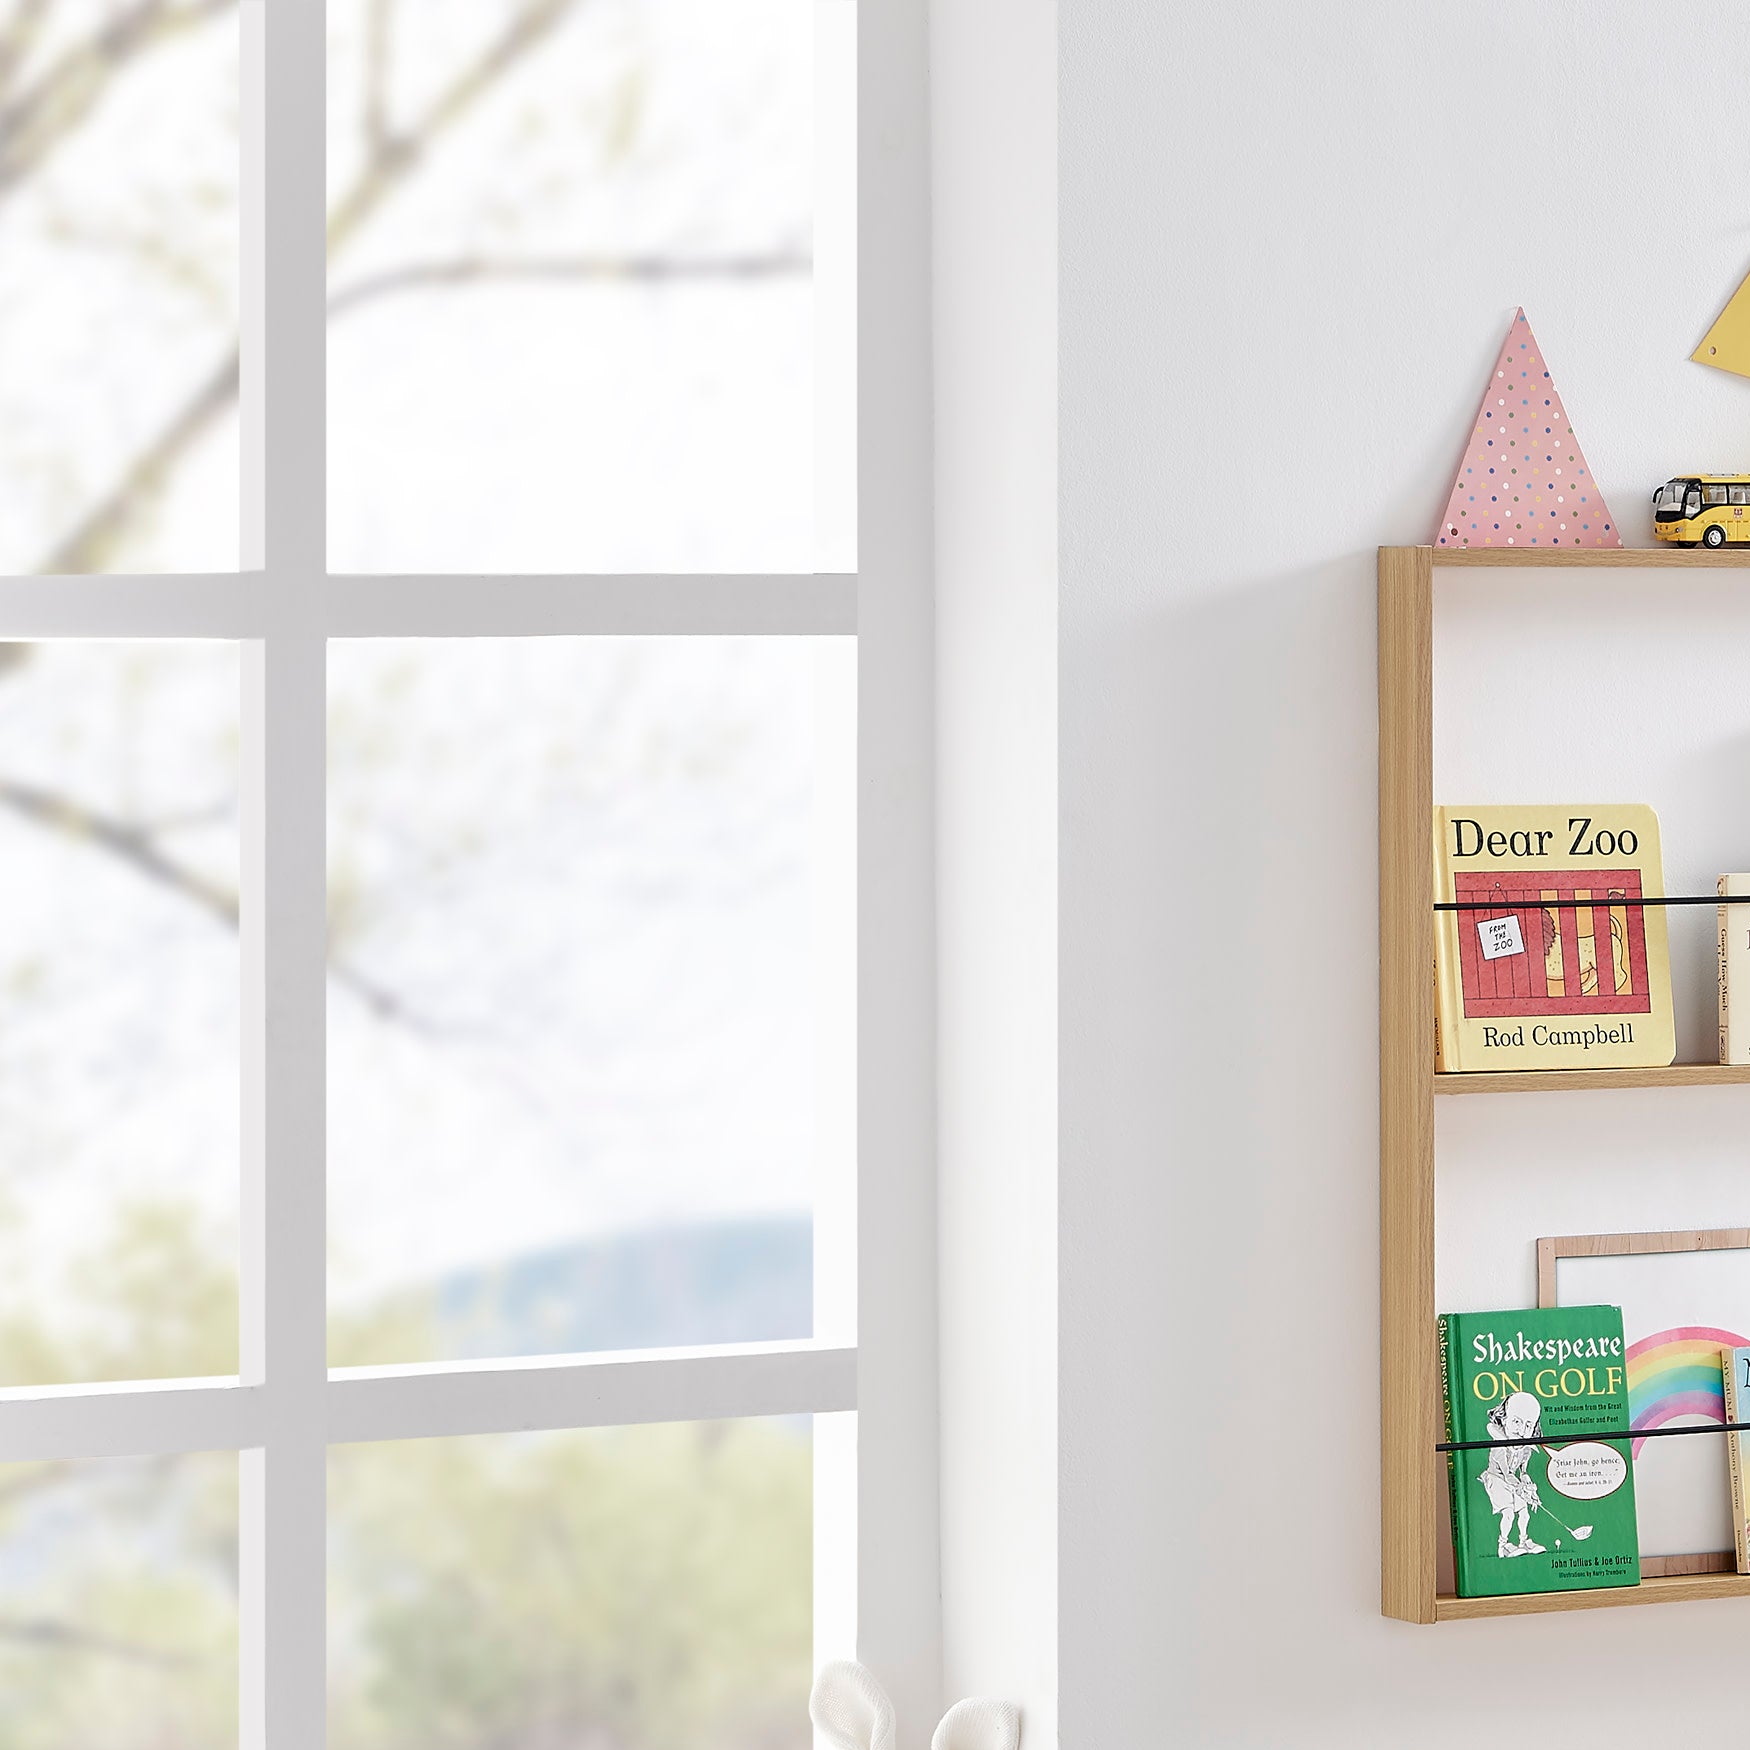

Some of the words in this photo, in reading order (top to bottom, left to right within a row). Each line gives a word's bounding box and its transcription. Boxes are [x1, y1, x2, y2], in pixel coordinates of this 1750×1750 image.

[1451, 819, 1554, 857] Dear
[1568, 818, 1639, 856] Zoo
[1489, 923, 1507, 934] FROM
[1493, 938, 1513, 951] ZOO
[1483, 1026, 1525, 1047] Rod
[1532, 1023, 1634, 1049] Campbell
[1438, 1319, 1449, 1396] Shakespeare
[1472, 1331, 1622, 1366] Shakespeare
[1723, 1360, 1730, 1378] MY
[1473, 1370, 1524, 1401] ON
[1534, 1366, 1623, 1398] GOLF
[1725, 1382, 1733, 1412] MUM
[1564, 1404, 1584, 1412] Wisdom
[1585, 1403, 1597, 1411] from
[1607, 1402, 1622, 1410] Great
[1729, 1431, 1738, 1472] Anthony
[1551, 1559, 1568, 1569] John
[1569, 1557, 1592, 1568] Tullius
[1594, 1557, 1599, 1566] &
[1601, 1556, 1613, 1566] Joe
[1615, 1554, 1633, 1565] Ortiz
